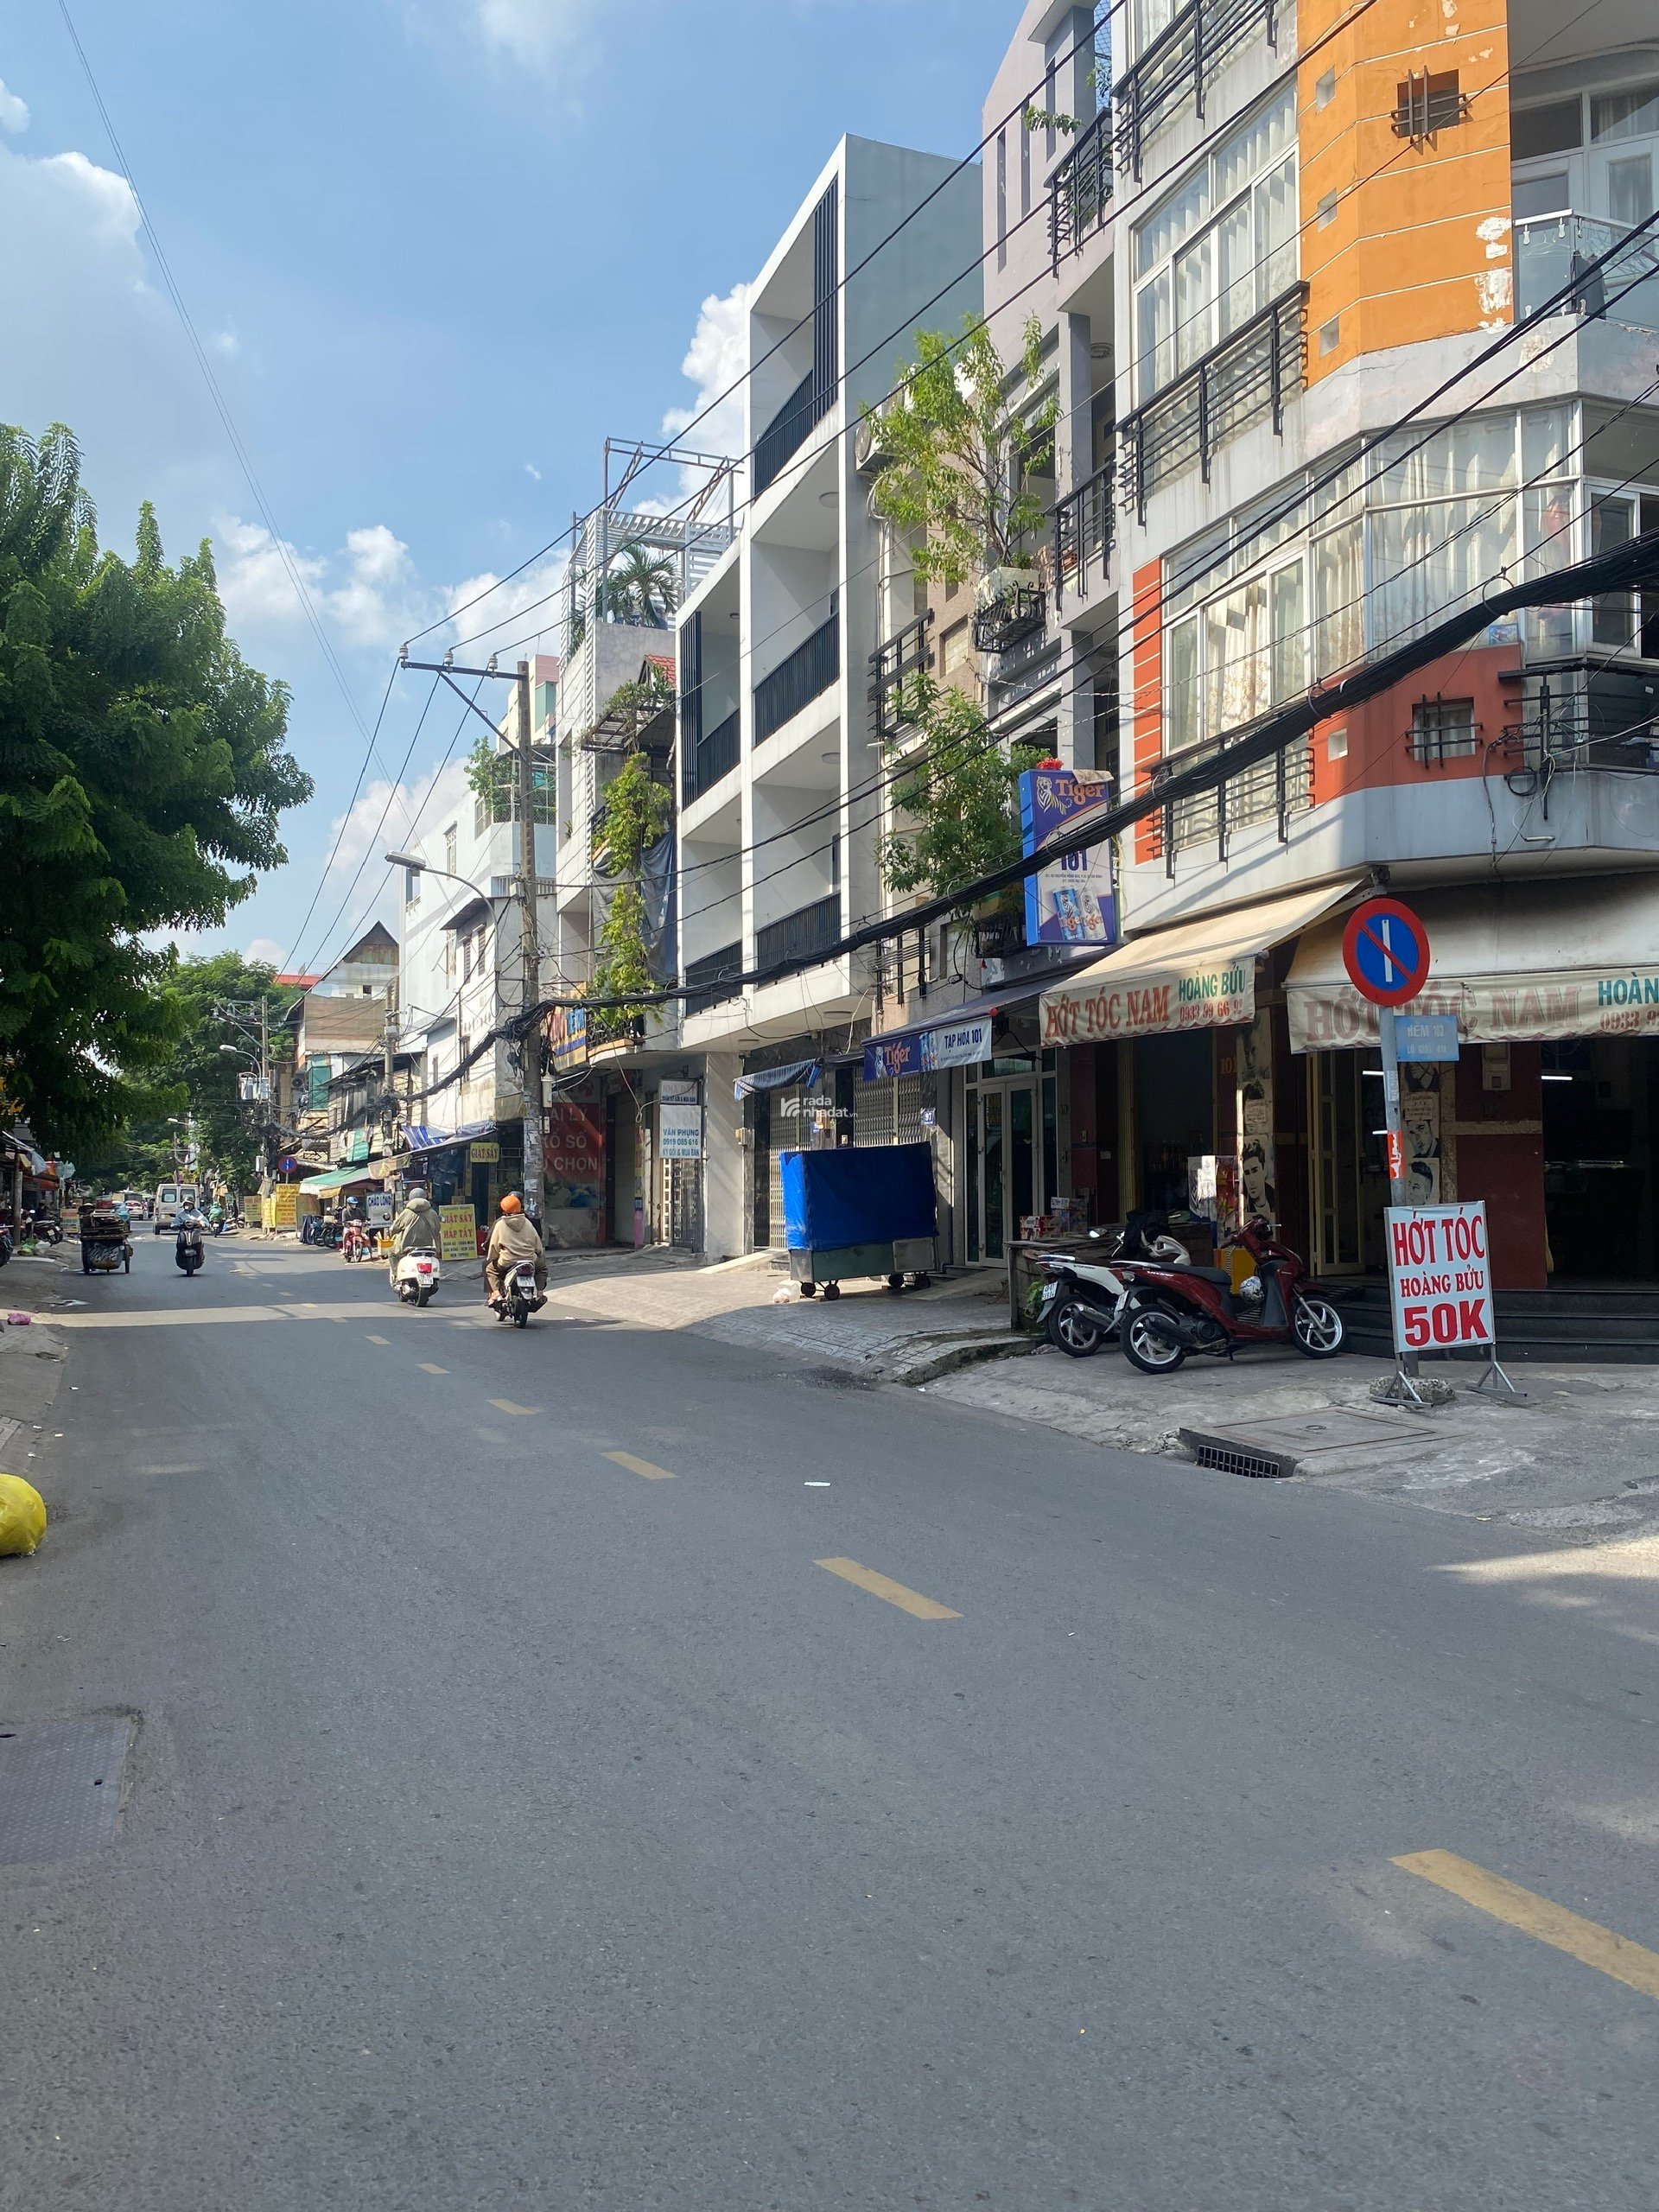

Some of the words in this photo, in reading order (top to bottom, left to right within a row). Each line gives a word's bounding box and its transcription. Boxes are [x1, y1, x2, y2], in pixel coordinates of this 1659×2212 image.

[1055, 779, 1106, 805] Tiger
[1179, 970, 1218, 1002] HOÀNG
[1221, 961, 1246, 995] BỬU
[1598, 971, 1659, 1007] HOÀN
[1044, 993, 1080, 1039] HỚT
[1085, 986, 1122, 1033] TÓC
[1126, 985, 1171, 1027] NAM
[1179, 1004, 1200, 1023] 0933
[1217, 1001, 1230, 1018] 66
[1489, 985, 1583, 1033] NAM
[1599, 1010, 1640, 1030] 0933
[1646, 1009, 1659, 1027] 9
[944, 1034, 957, 1053] TẠP
[957, 1027, 970, 1046] HÓA
[971, 1027, 982, 1044] 101
[884, 1041, 911, 1074] Tiger
[677, 1128, 700, 1138] PHỤNG
[553, 1156, 598, 1174] CHỌN
[1392, 1211, 1436, 1267] HỚT
[1441, 1206, 1485, 1262] TÓC
[1400, 1270, 1452, 1298] HOÀNG
[1455, 1263, 1484, 1293] BỬU
[1403, 1298, 1489, 1347] 50K
